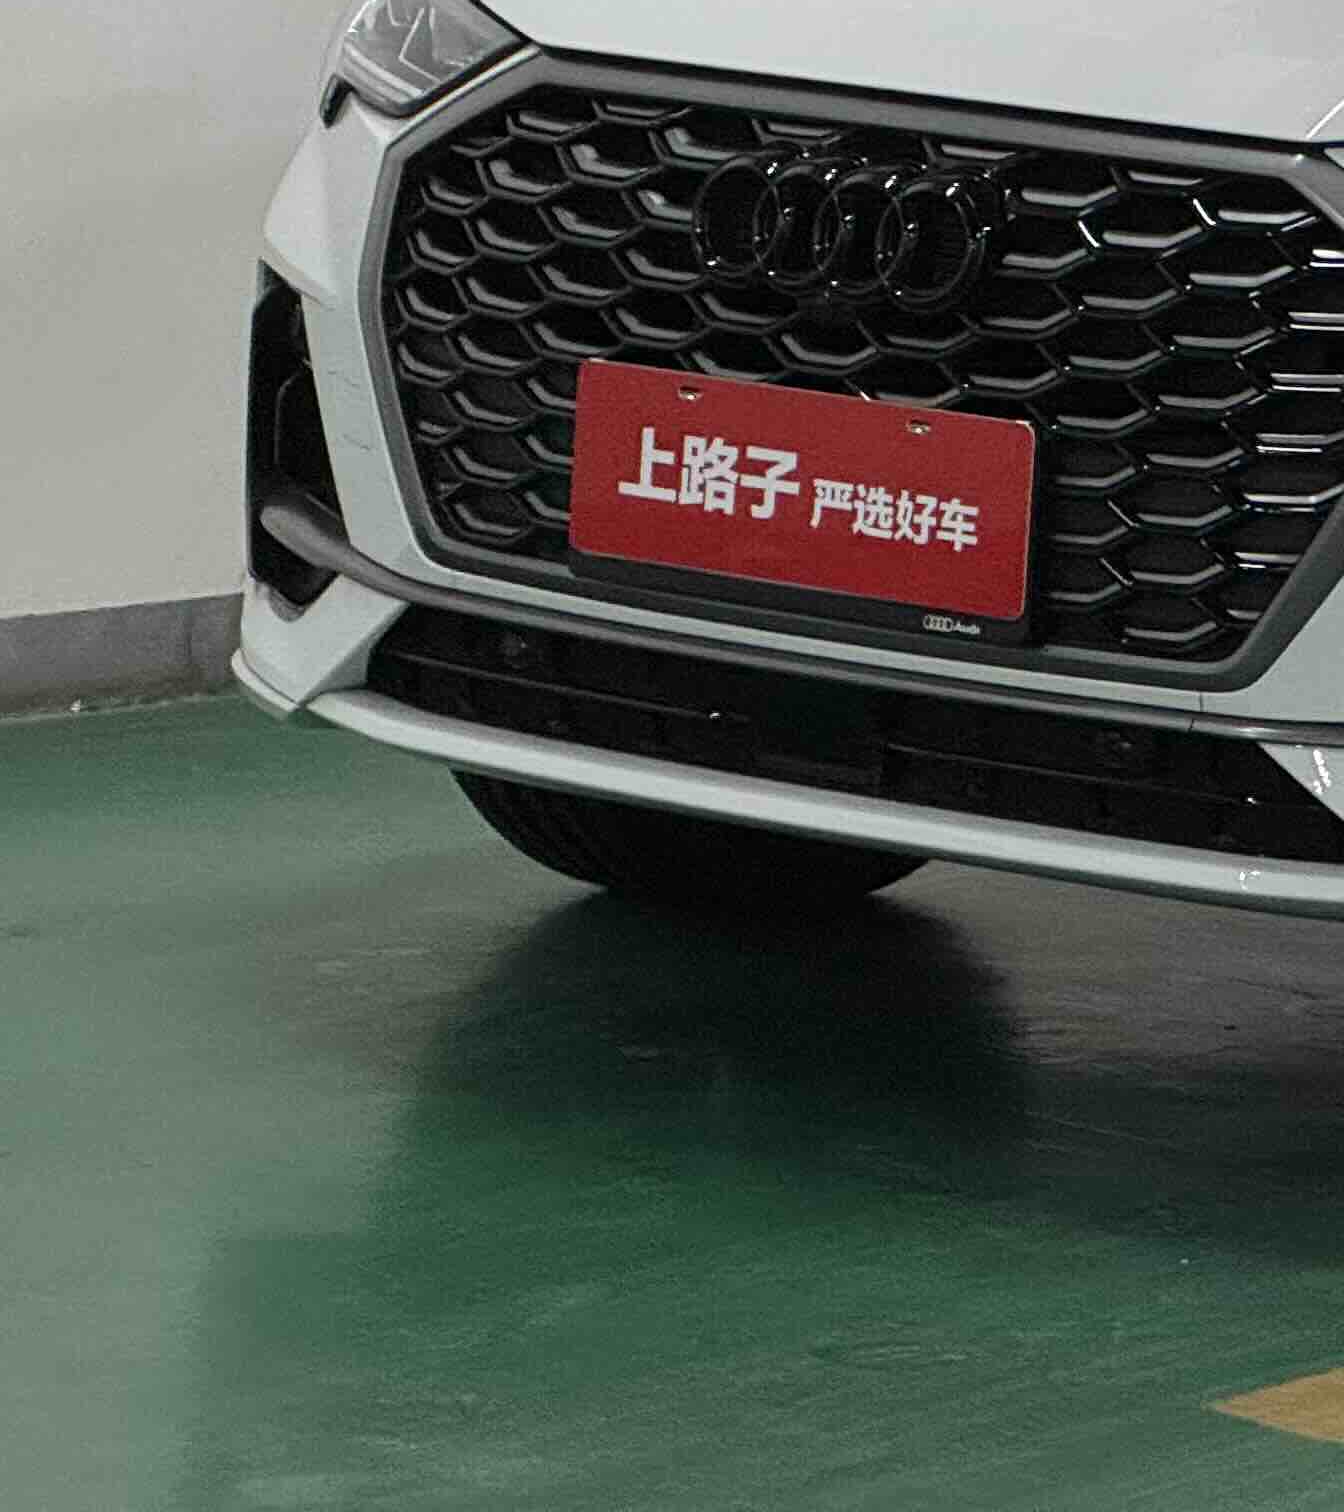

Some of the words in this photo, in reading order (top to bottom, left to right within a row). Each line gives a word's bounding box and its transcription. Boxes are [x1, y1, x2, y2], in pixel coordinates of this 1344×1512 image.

[618, 427, 800, 519] 上路子
[810, 478, 980, 552] 严选好车
